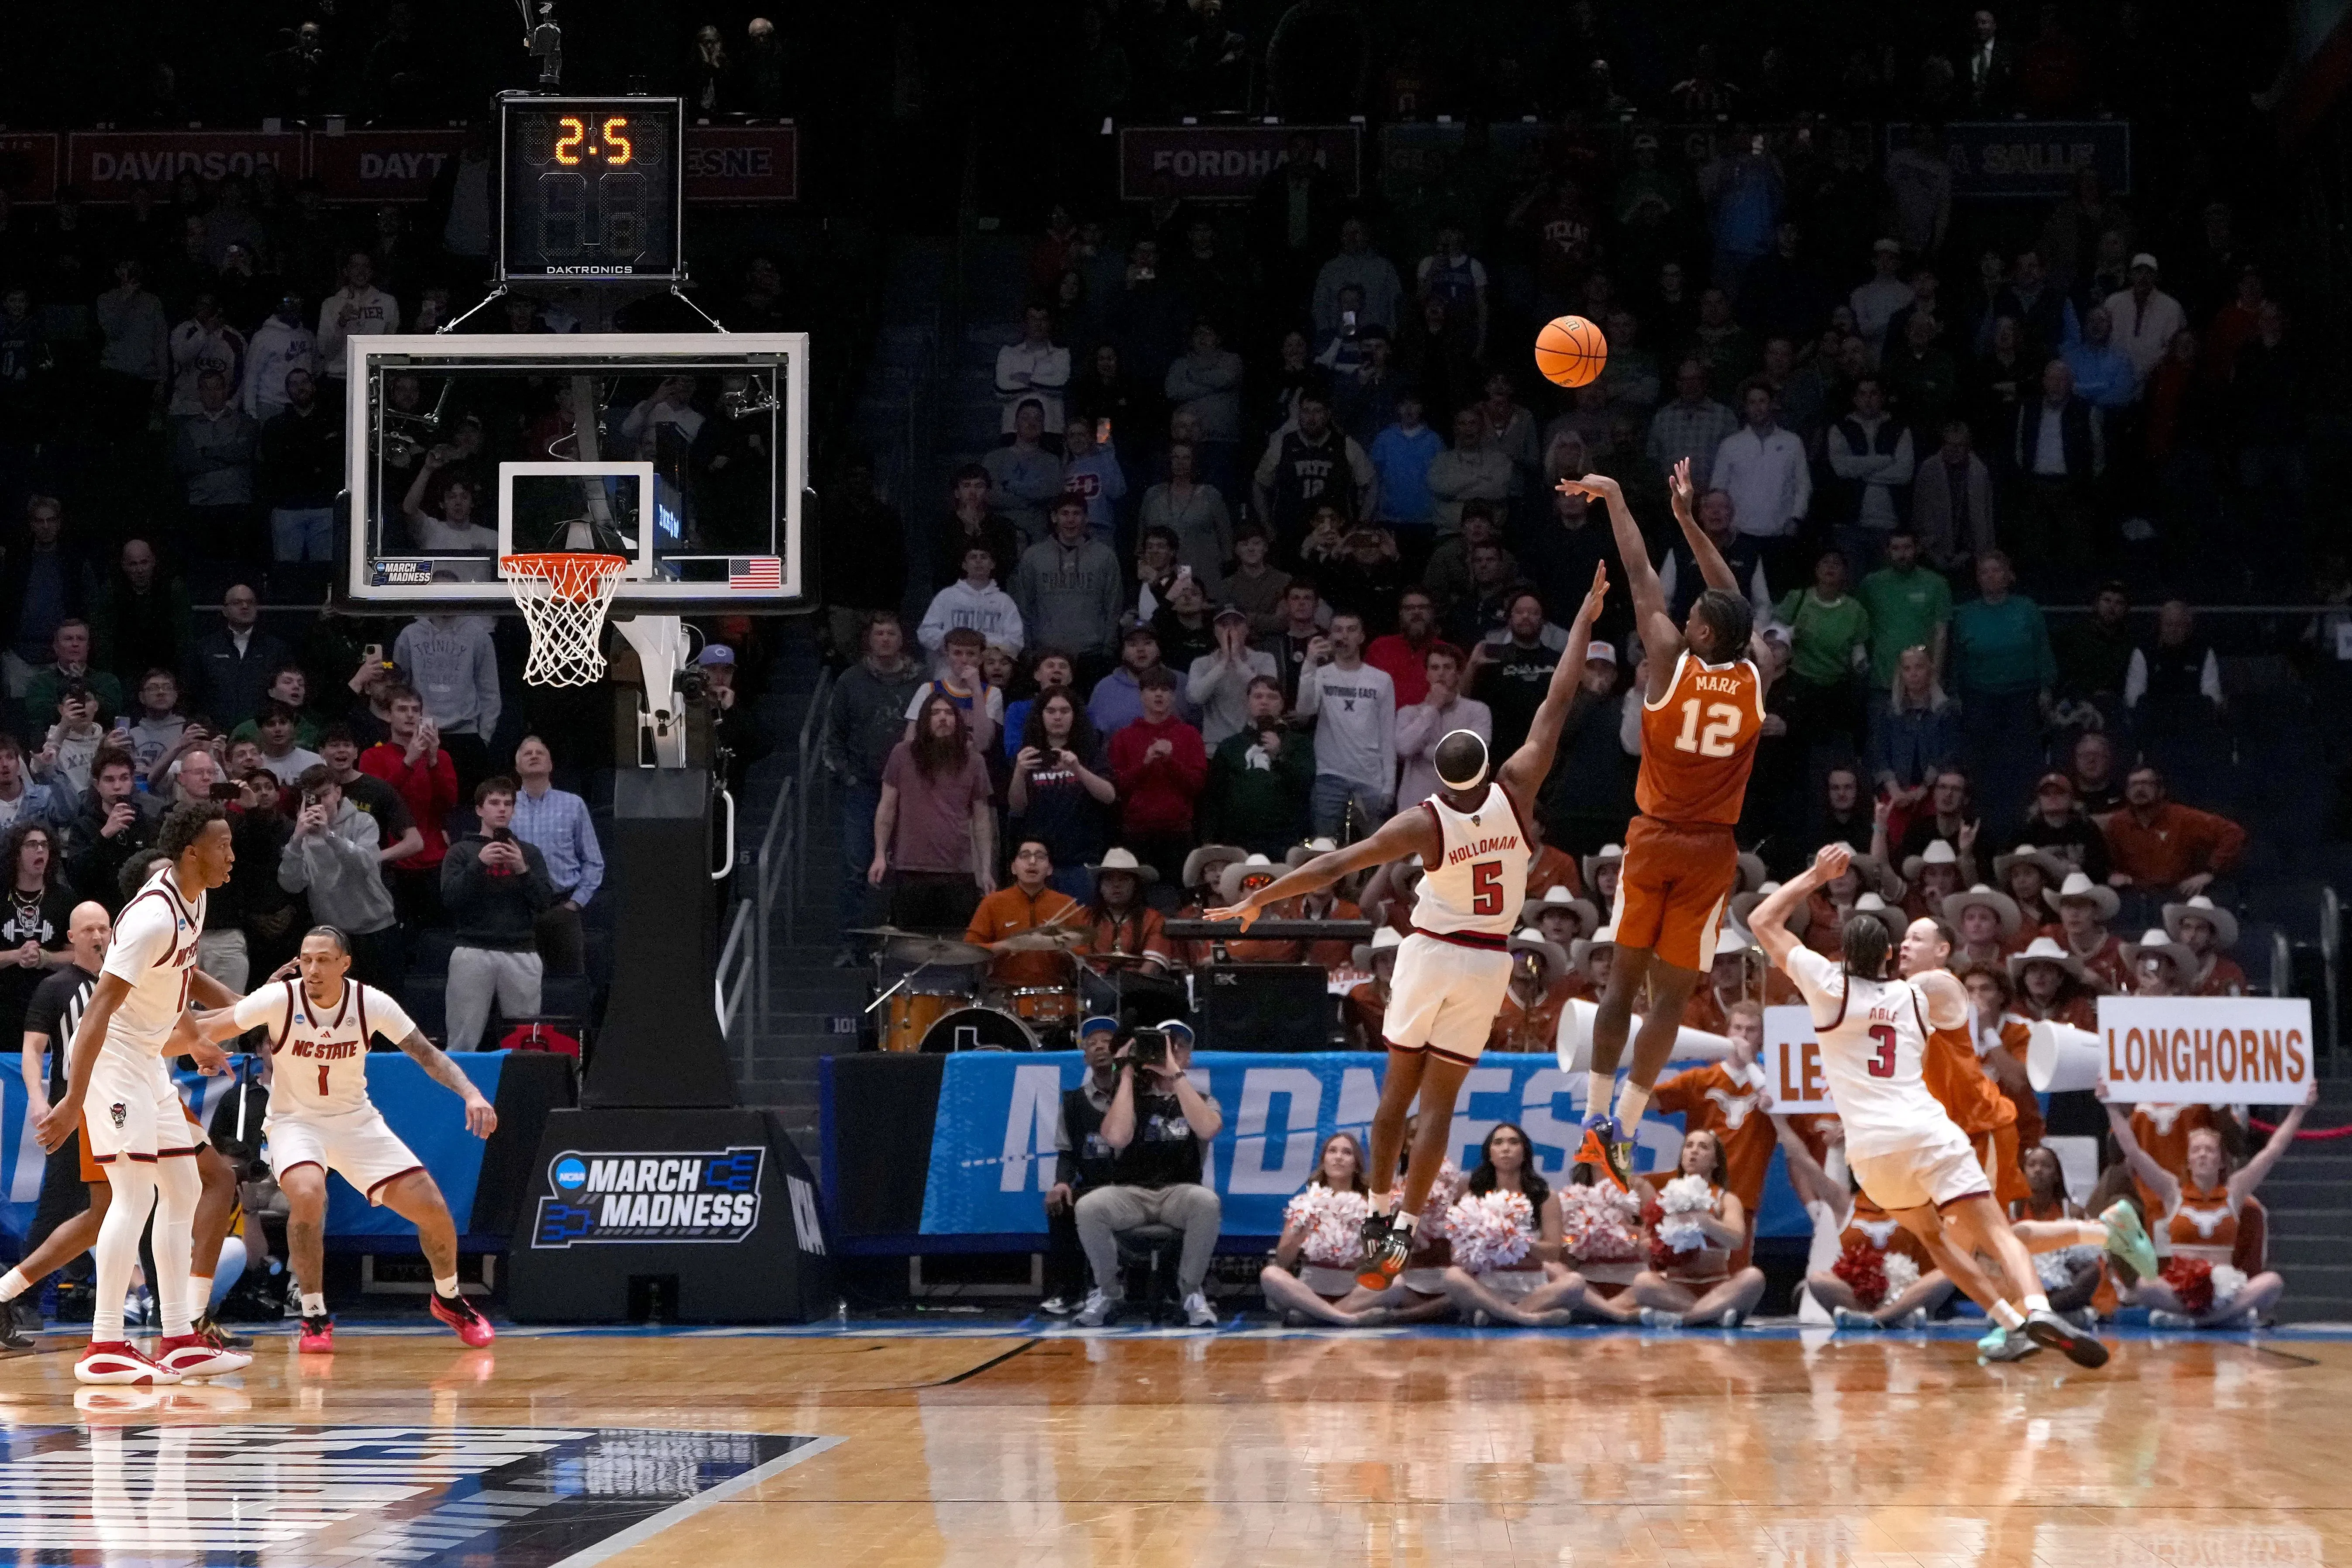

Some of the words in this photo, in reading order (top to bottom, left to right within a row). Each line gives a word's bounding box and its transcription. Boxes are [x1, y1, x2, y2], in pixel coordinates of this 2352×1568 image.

[546, 266, 633, 275] DAKTRONICS
[385, 563, 417, 572] MARCH
[388, 572, 431, 582] MADNESS
[1695, 675, 1741, 695] MARK
[1344, 700, 1355, 712] X
[1675, 697, 1743, 758] 12
[1449, 836, 1518, 866] HOLLOMAN
[1472, 860, 1503, 916] 5
[833, 1017, 857, 1034] 101
[292, 1040, 314, 1058] NC
[314, 1040, 359, 1060] STATE
[1868, 1024, 1896, 1078] 3
[2108, 1027, 2305, 1082] LONGHORNS
[318, 1065, 330, 1096] 1
[586, 1159, 702, 1193] MARCH
[599, 1194, 757, 1227] MADNESS
